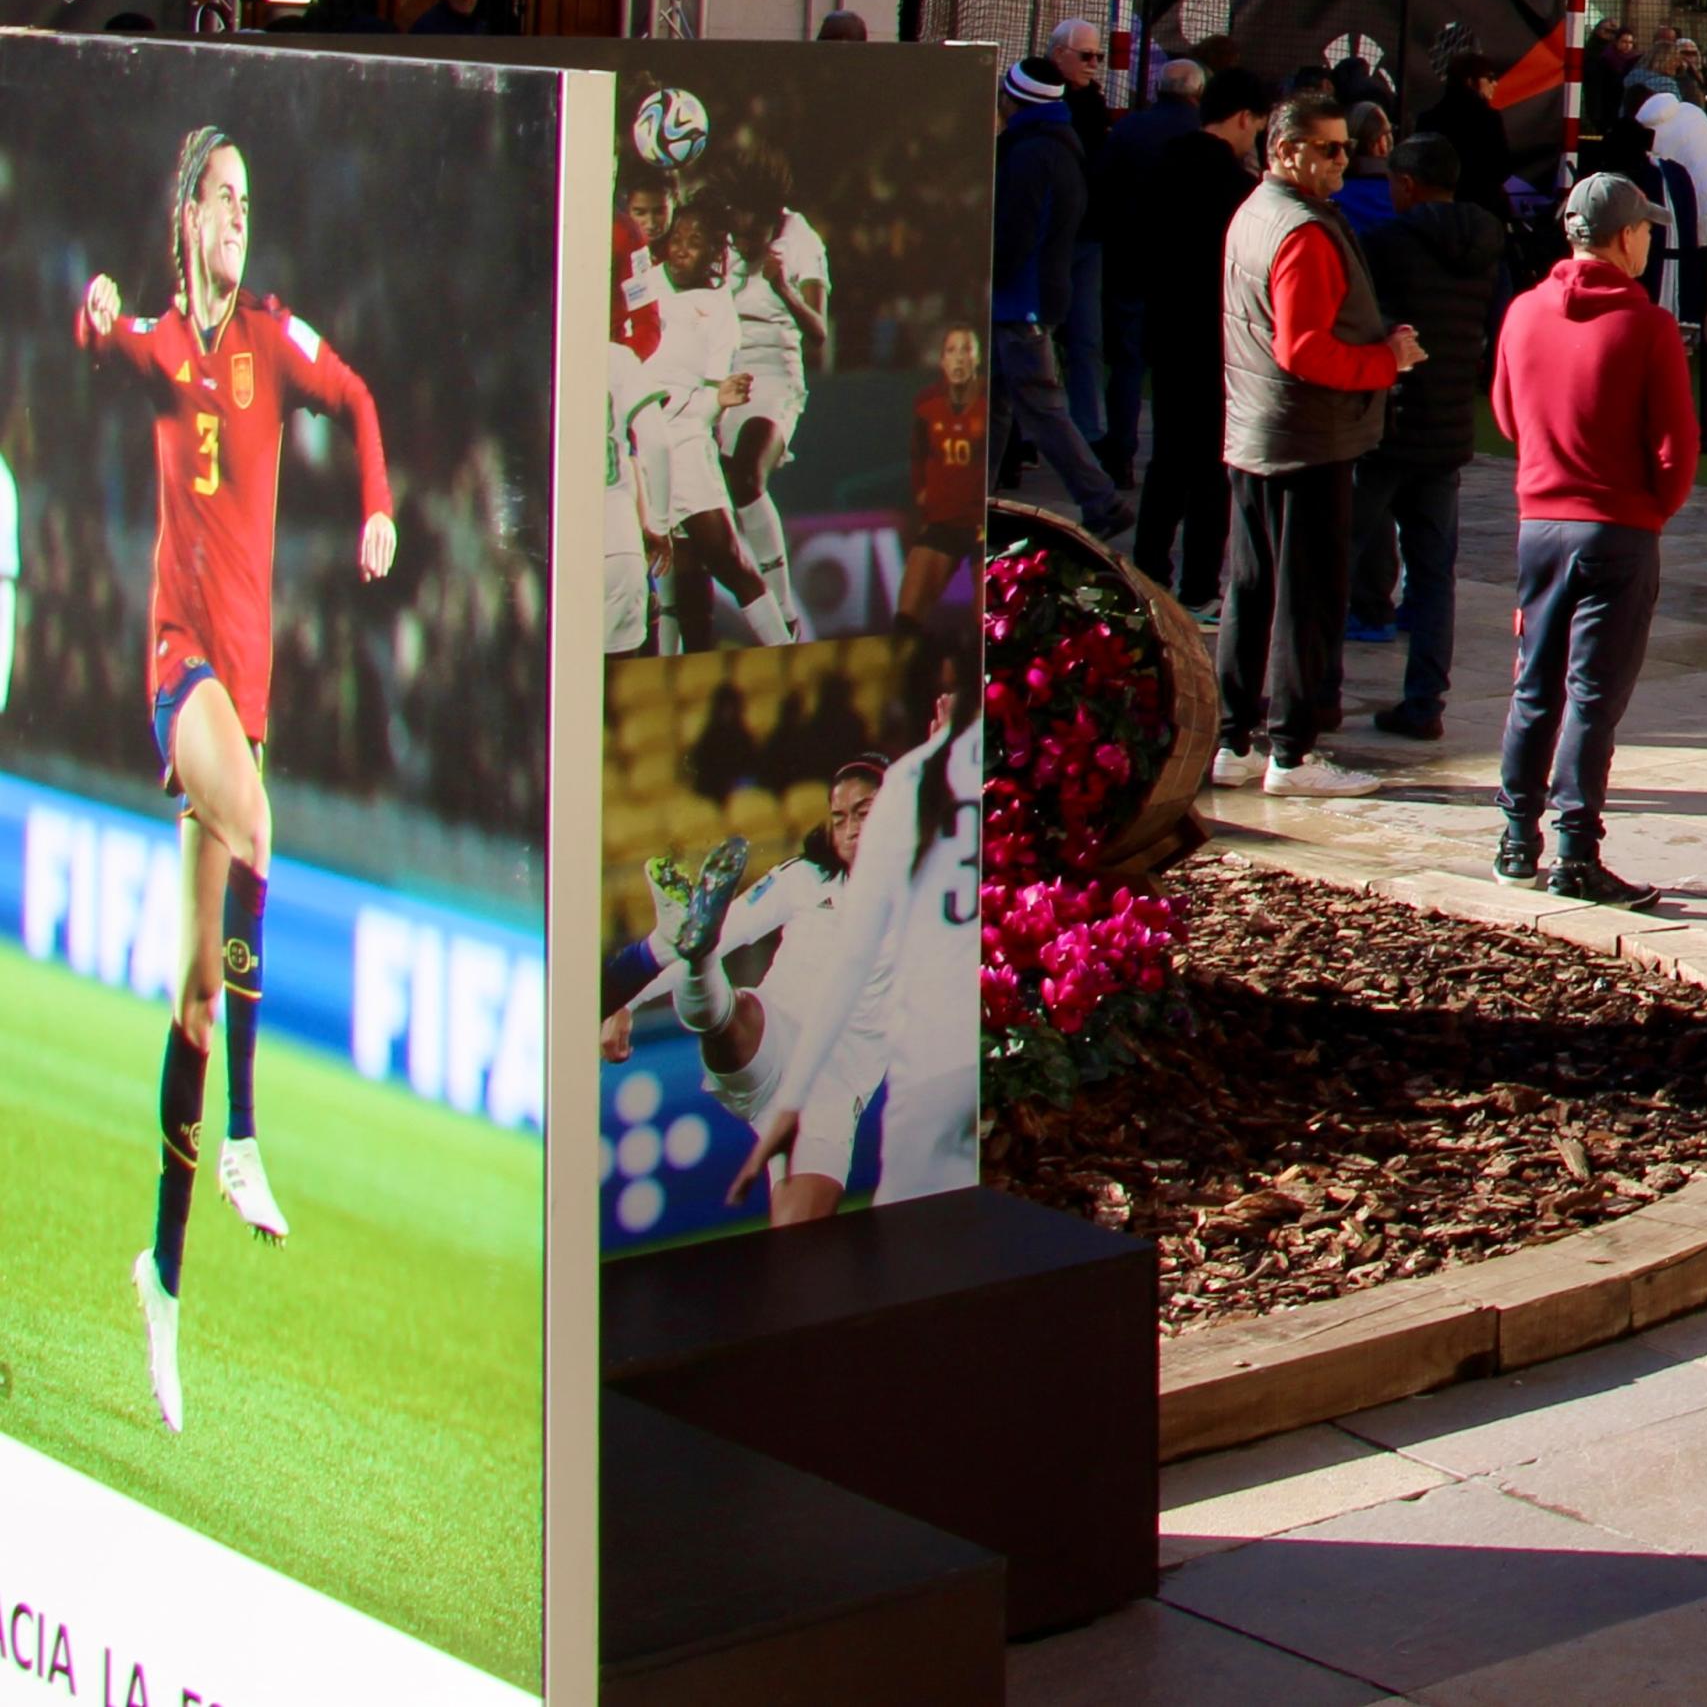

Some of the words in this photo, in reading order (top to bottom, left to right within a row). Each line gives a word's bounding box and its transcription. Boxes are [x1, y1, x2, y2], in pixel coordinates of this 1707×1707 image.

[194, 412, 219, 496] 3
[943, 439, 972, 465] 10
[352, 903, 546, 1136] FIFA
